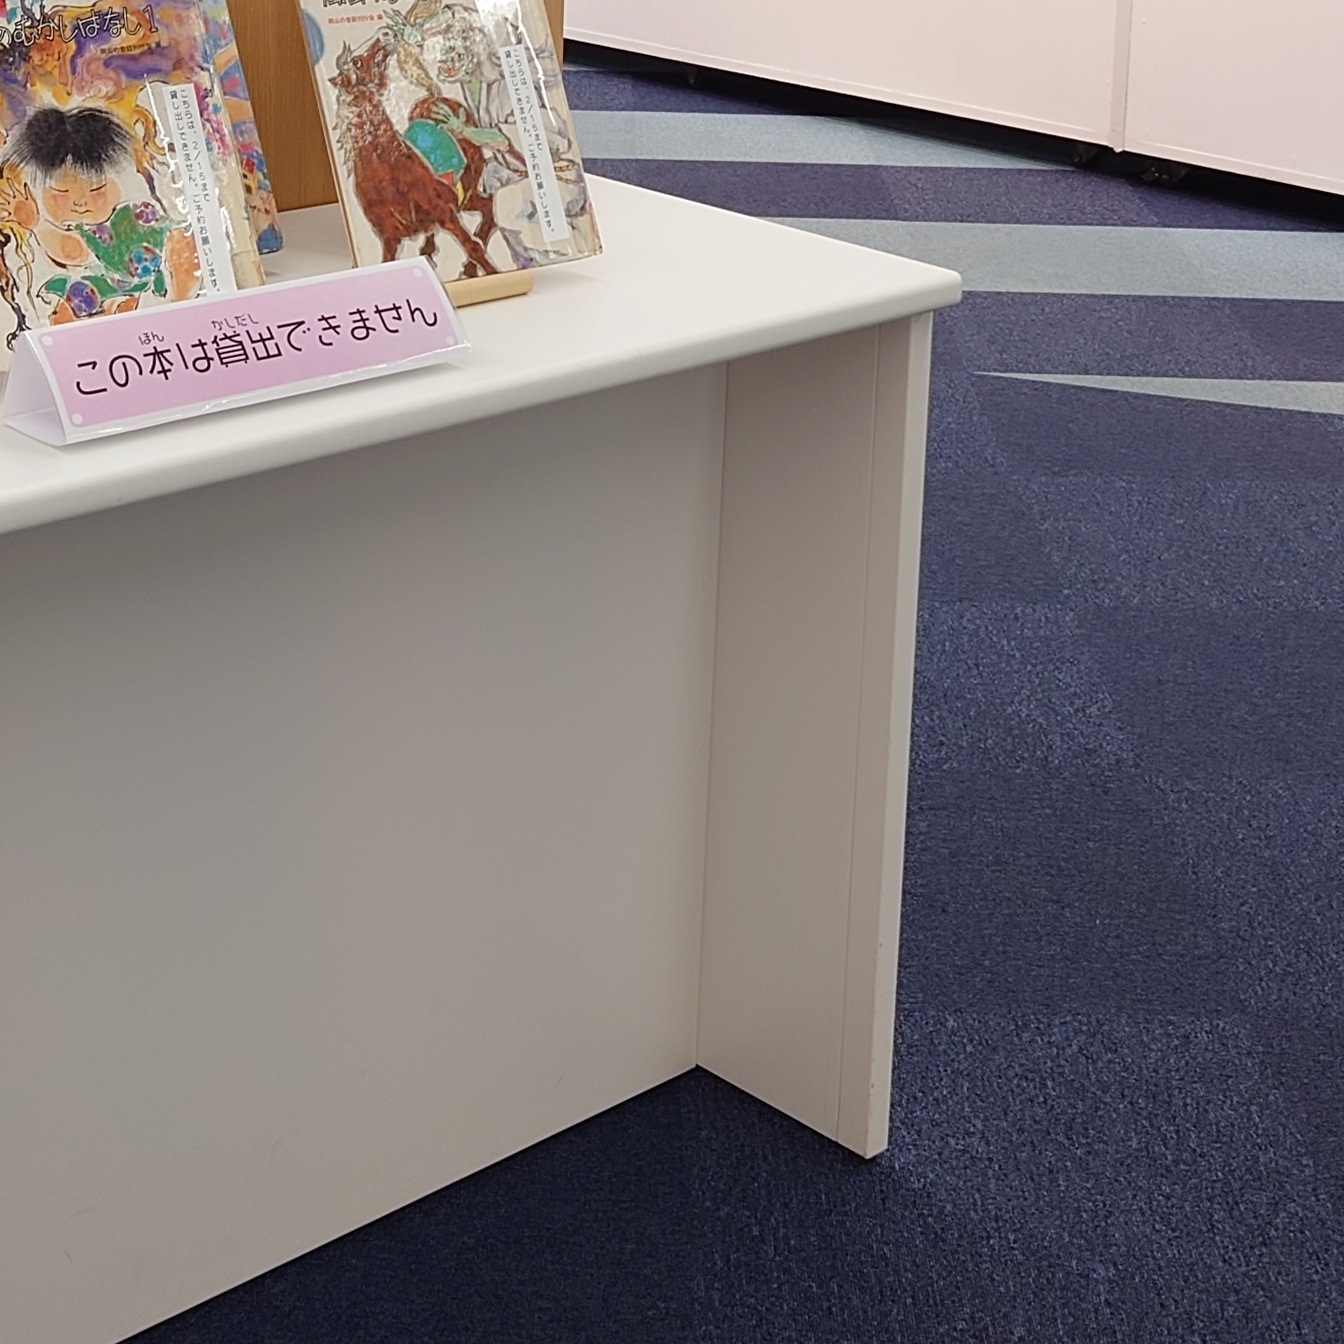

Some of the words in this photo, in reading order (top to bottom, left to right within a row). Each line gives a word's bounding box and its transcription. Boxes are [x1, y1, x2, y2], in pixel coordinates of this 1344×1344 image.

[211, 314, 259, 330] かしだし
[138, 331, 165, 346] ほん
[75, 298, 439, 396] この本は貸出できません
